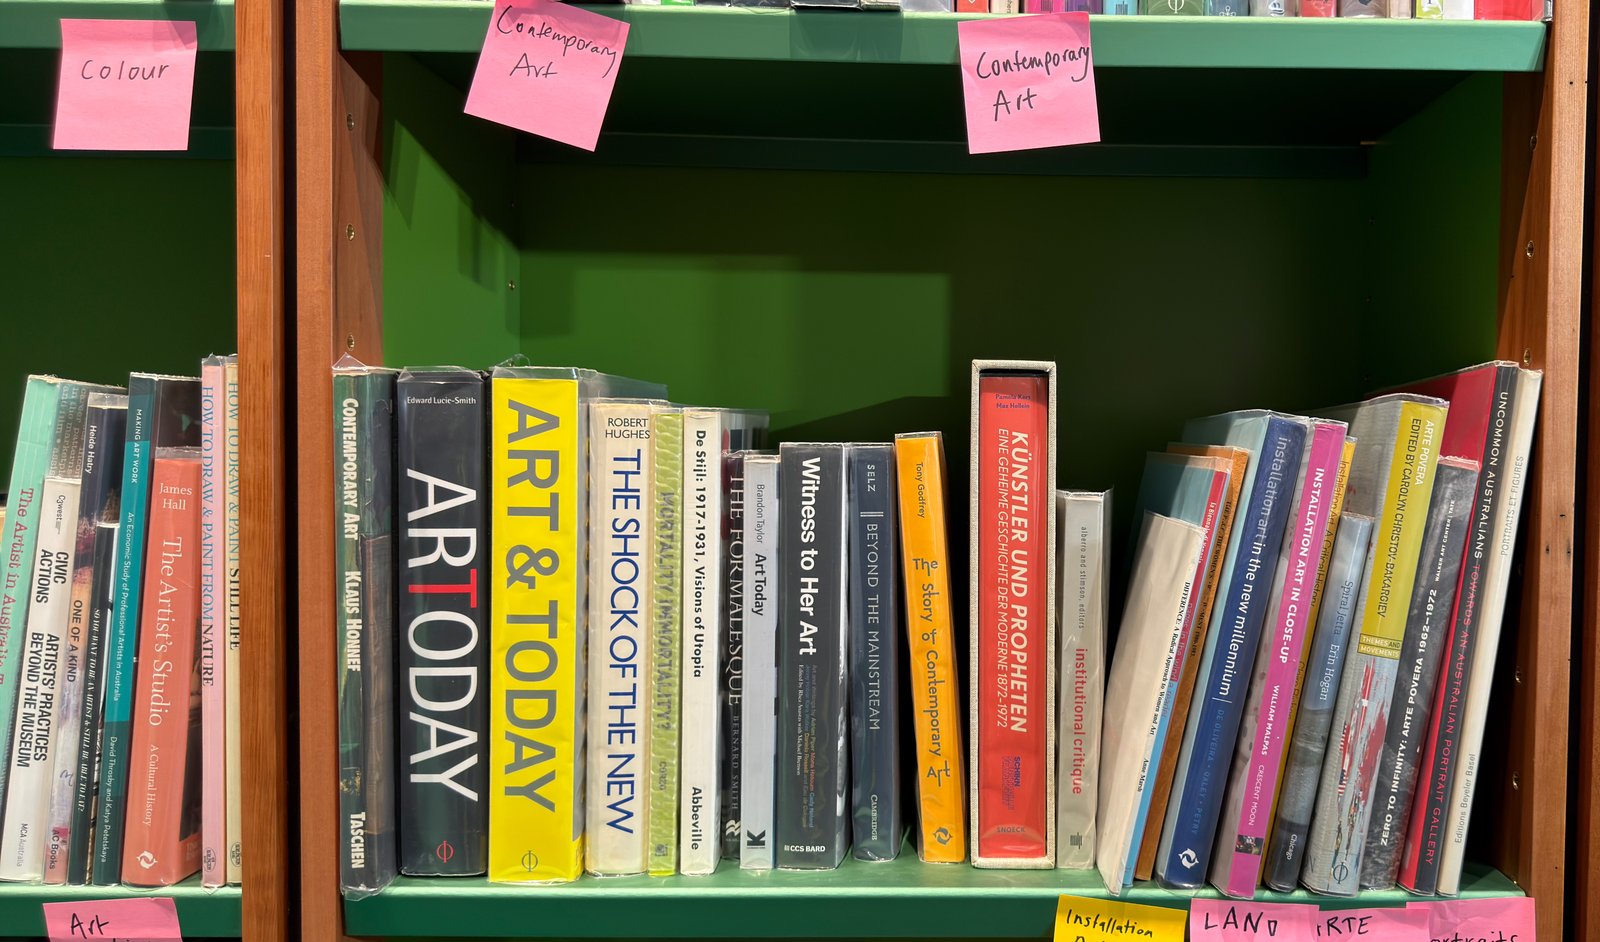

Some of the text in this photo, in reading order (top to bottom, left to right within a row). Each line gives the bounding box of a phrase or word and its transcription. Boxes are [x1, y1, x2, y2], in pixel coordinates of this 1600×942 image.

[80, 59, 170, 81] Colour
[497, 4, 617, 79] Contemporary
[509, 52, 558, 78] Art
[976, 46, 1090, 82] Contemporary
[992, 87, 1038, 122] Art
[407, 396, 477, 405] Edward Lucie-Smith
[605, 429, 651, 440] HUGHES
[607, 417, 649, 428] ROBERT
[130, 408, 143, 485] MAKING ART WORK
[342, 398, 361, 541] CONTEMPORARY ART
[866, 464, 877, 492] SELZ
[1414, 419, 1436, 487] ARTE POVERA
[160, 484, 193, 497] James
[162, 498, 187, 511] Hall
[755, 483, 767, 544] Brandon Taylor
[801, 456, 821, 543] Witness
[913, 462, 927, 520] Tony Godfrey
[1299, 467, 1326, 558] INSTALLATION
[1376, 418, 1423, 620] EDITED BY CAROLYN CHRISTOV-BAKARGIEV
[53, 551, 70, 584] CIVIC
[202, 385, 214, 688] HOW TO DRAW & PAINT FROM NATURE
[690, 429, 707, 678] De Stijl: 1917-1931, Visions of Utopia
[800, 549, 819, 571] to
[1218, 436, 1292, 697] installation art in the new millennium
[35, 548, 54, 604] ACTIONS
[725, 473, 744, 706] THE FORMALESQUE
[751, 552, 768, 617] Art Today
[800, 577, 819, 617] Her
[996, 427, 1009, 729] EINE GEHEIME GESCHICHTE DER MODERNE 1872-1972
[1009, 430, 1032, 733] KÜNSTLER UND PROPHETEN
[1077, 525, 1089, 630] alberro and stimson, editors
[1290, 587, 1302, 602] IN
[1293, 558, 1307, 585] ART
[148, 536, 183, 727] The Artist’s Studio
[344, 569, 363, 672] KLAUS HONNEF
[407, 467, 478, 802] ARTODAY
[504, 398, 561, 814] ART & TODAY
[799, 620, 819, 656] Art
[866, 523, 881, 731] BEYOND THE MAINSTREAM
[1279, 604, 1299, 664] CLOSE-UP
[1332, 579, 1355, 636] Spiral Jetta
[1424, 390, 1509, 866] UNCOMMON AUSTRALIANS TOWARDS AN AUSTRALIAN PORTRAIT GALLERY
[67, 600, 83, 683] ONE OF A KIND
[605, 448, 642, 835] THE SHOCK OF THE NEW
[912, 559, 951, 788] The Story of Contemporary Art
[1319, 643, 1341, 702] Erin Hogan
[16, 631, 45, 768] BEYOND THE MUSEUM
[33, 632, 60, 762] ARTISTS’ PRACTICES
[1069, 647, 1088, 795] institutional critique
[1260, 684, 1281, 757] WILLIAM MALPAS
[1380, 588, 1438, 847] ZERO TO INFINITY: ARTE POVERA 1962-1972
[142, 744, 160, 827] A Cultural History
[731, 715, 741, 810] BERNARD SMITH
[1247, 764, 1266, 826] CRESCENT MOON
[99, 736, 119, 864] David Throsby and Katya Petetskaya
[690, 786, 703, 851] Abbeville
[870, 794, 879, 841] CAMBRIDGE
[1453, 753, 1477, 845] Editions Beyeler Basel
[350, 811, 366, 869] TASCHEN
[790, 844, 805, 852] CCS
[1285, 834, 1299, 861] Chicago
[70, 912, 110, 940] Art
[1065, 908, 1153, 937] Installation
